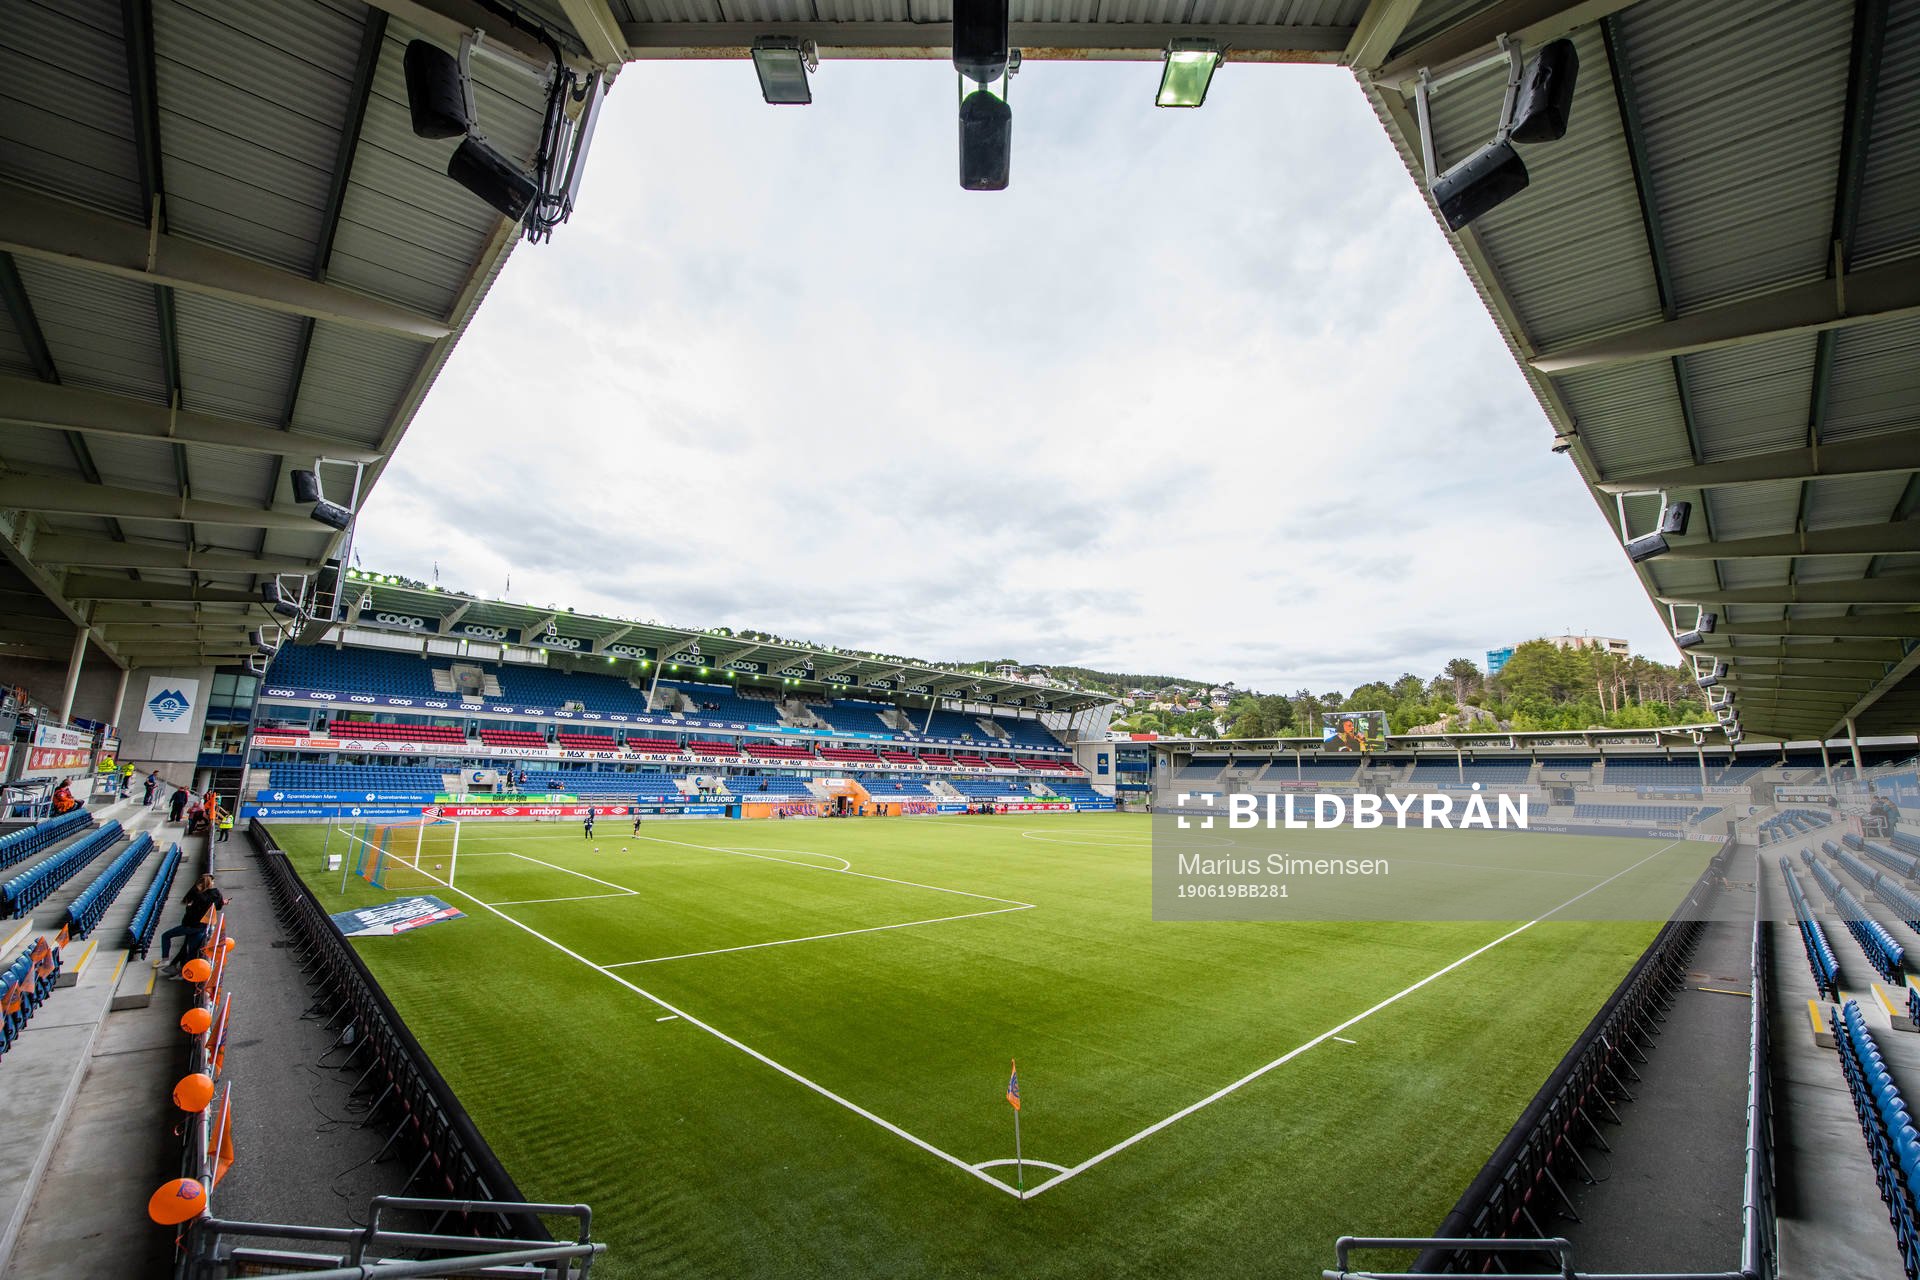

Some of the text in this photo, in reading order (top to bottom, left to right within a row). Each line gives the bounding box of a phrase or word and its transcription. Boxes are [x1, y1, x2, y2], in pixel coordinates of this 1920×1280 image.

[376, 613, 424, 629] coop
[464, 625, 507, 640] coop
[542, 635, 580, 649] coop
[612, 644, 646, 658] coop
[675, 653, 705, 665] coop
[731, 660, 758, 672] coop
[782, 667, 807, 678] coop
[268, 689, 295, 698] coop
[310, 692, 337, 701] coop
[350, 695, 375, 703] coop
[389, 698, 412, 706] coop
[425, 701, 448, 709] coop
[460, 703, 481, 711] coop
[493, 706, 513, 714] coop
[524, 708, 544, 716] coop
[610, 714, 628, 722] coop
[1567, 738, 1586, 746] MAX
[457, 808, 491, 816] umbro
[1659, 830, 1683, 838] fotball
